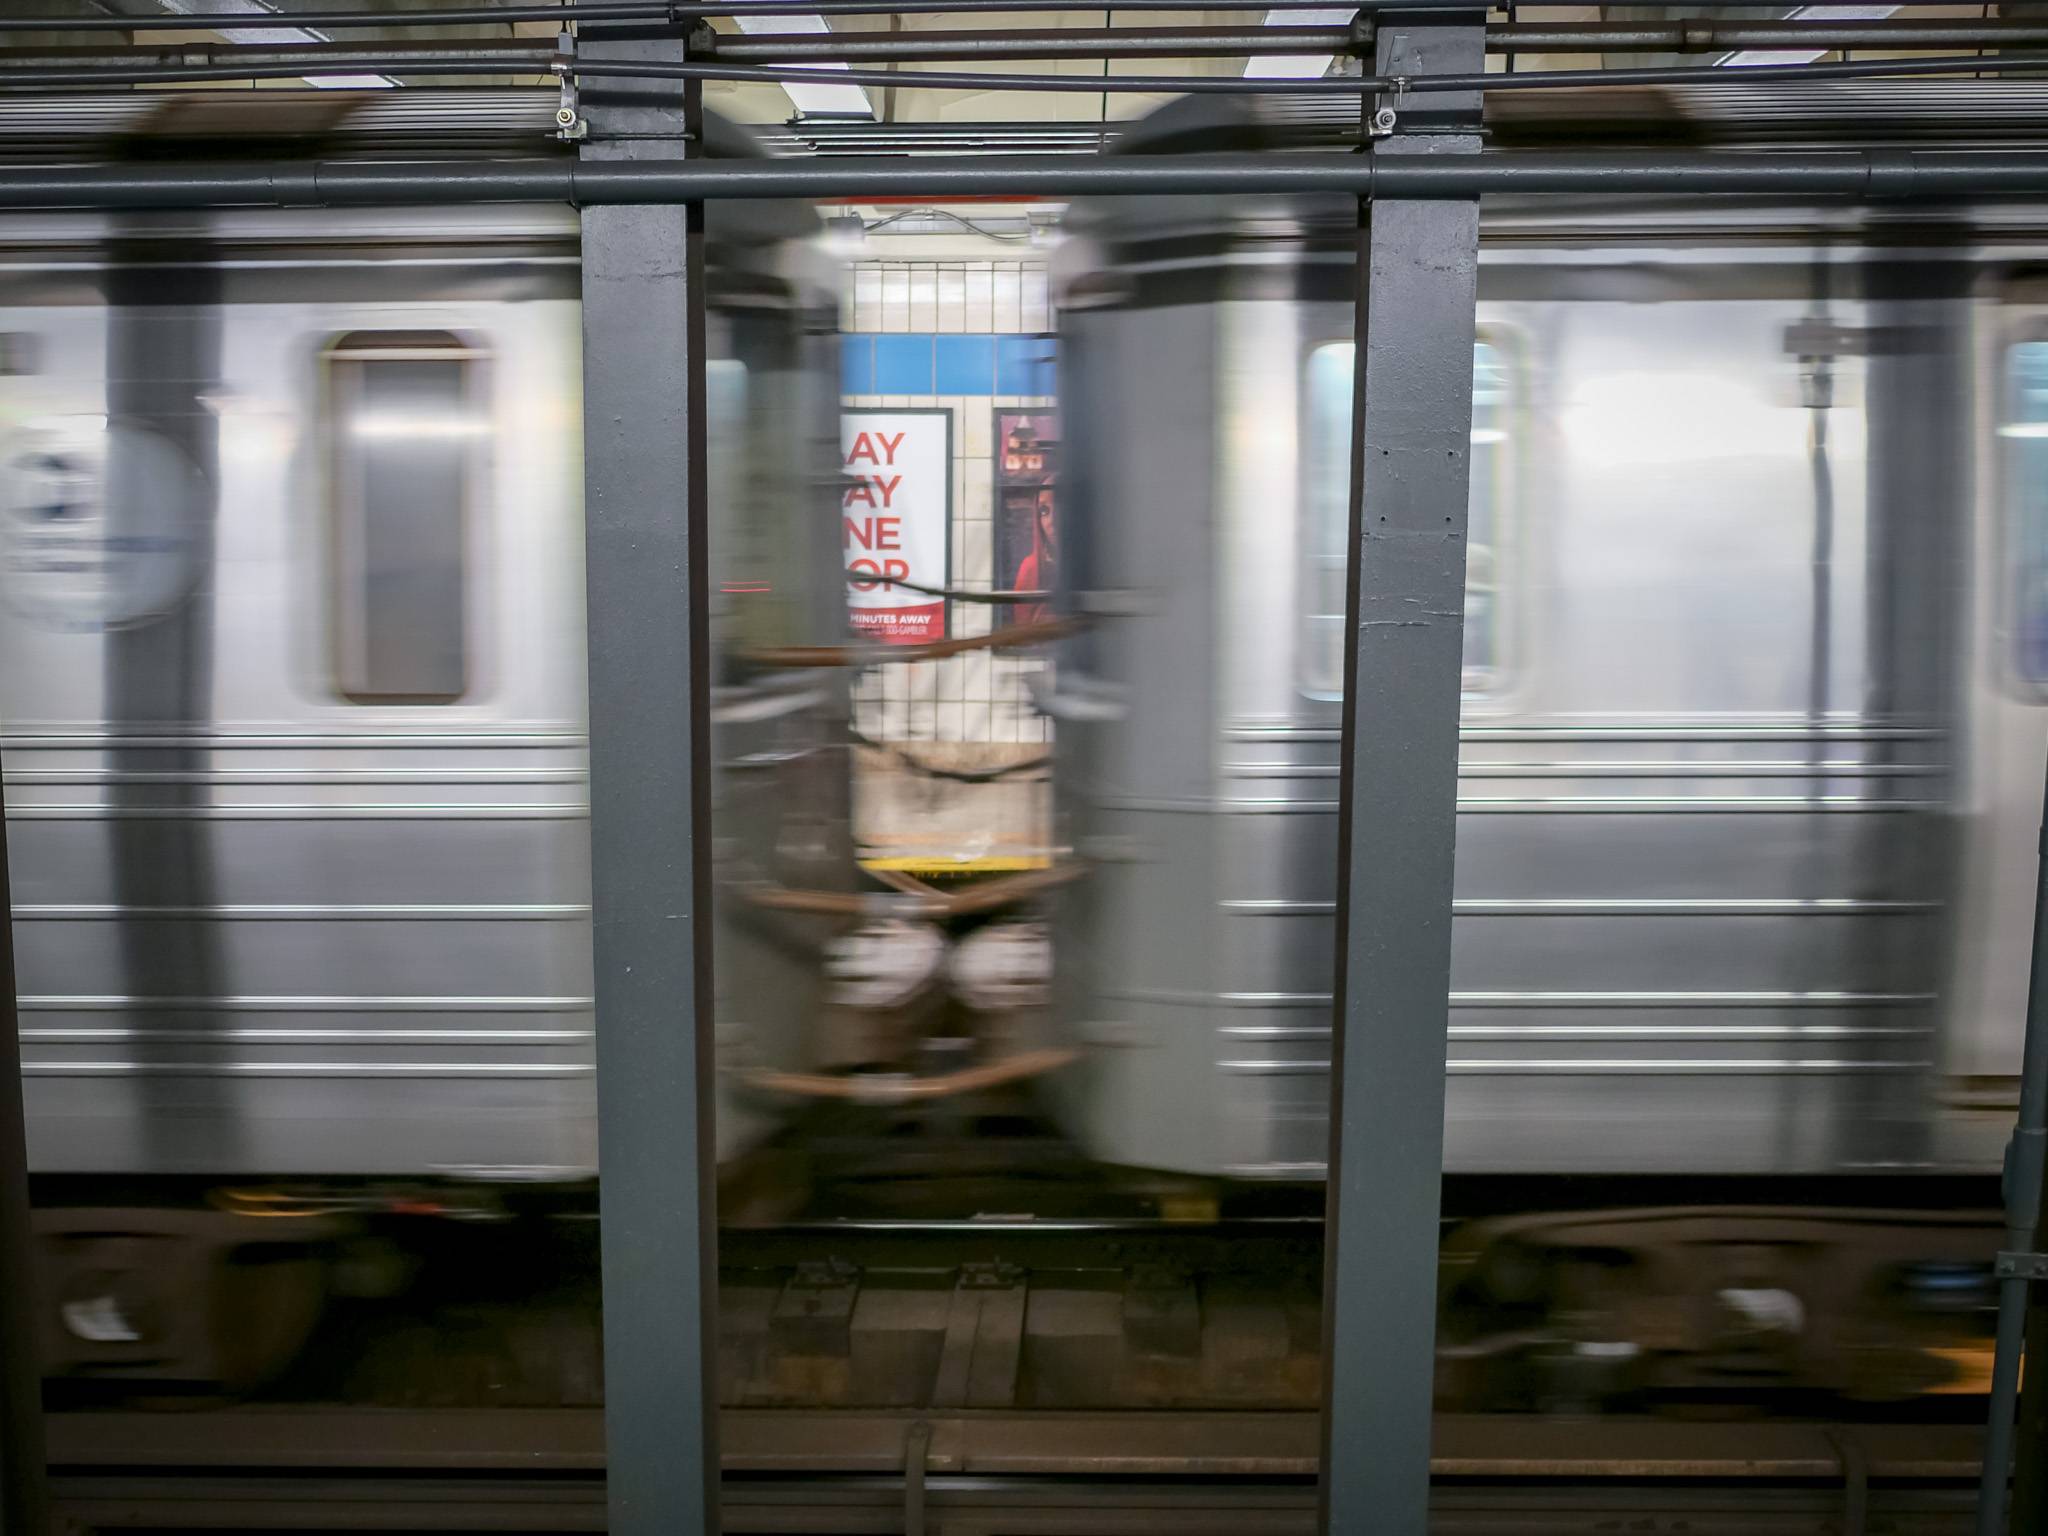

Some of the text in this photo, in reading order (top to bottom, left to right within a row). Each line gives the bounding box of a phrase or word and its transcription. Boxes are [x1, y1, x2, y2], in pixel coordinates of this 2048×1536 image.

[843, 432, 906, 466] AY
[850, 614, 932, 625] MINUTES AWAY
